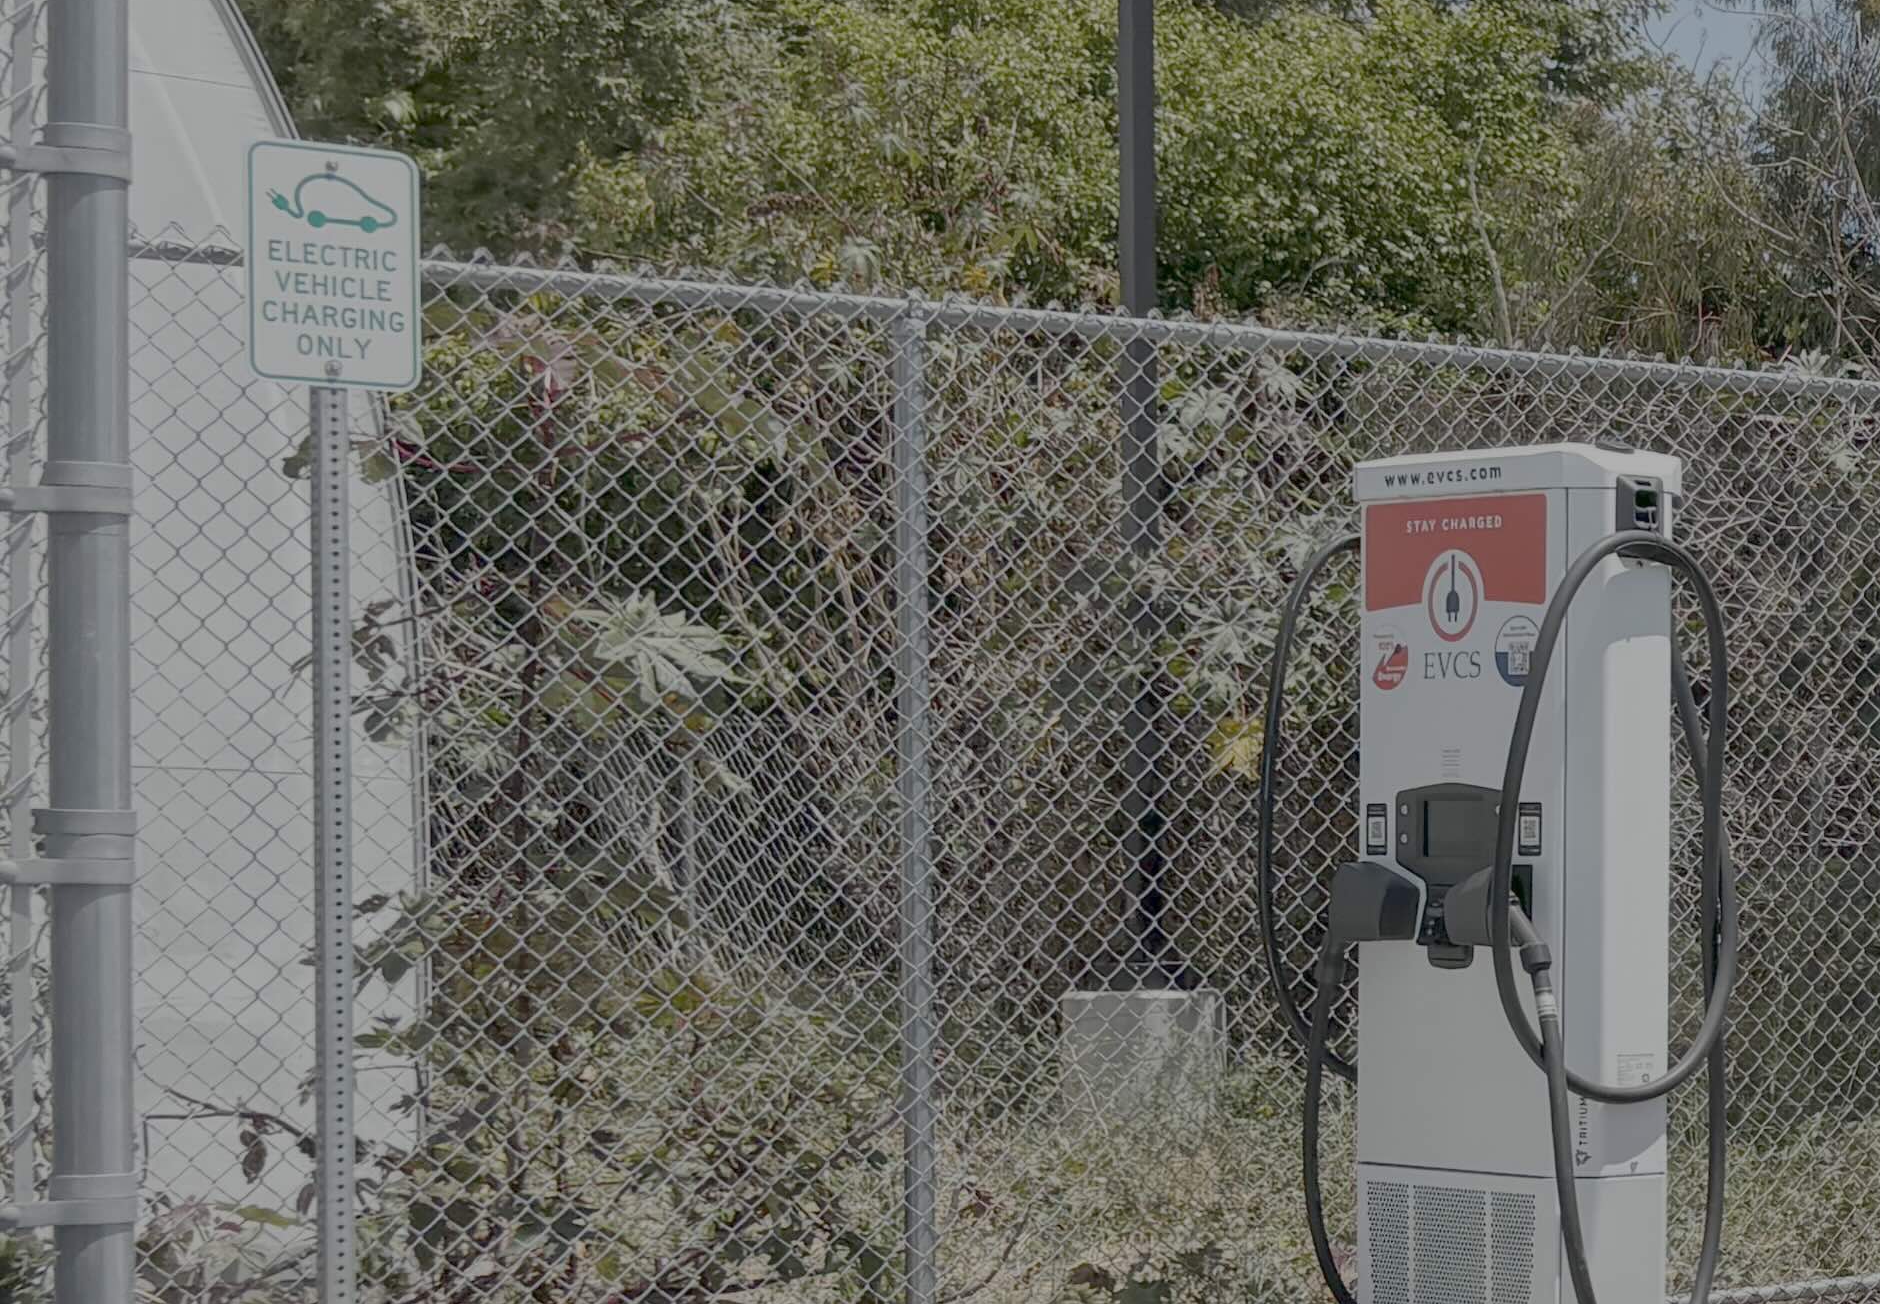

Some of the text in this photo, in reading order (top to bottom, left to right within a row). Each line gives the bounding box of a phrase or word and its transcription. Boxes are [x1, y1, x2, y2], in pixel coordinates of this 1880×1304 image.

[267, 239, 398, 273] ELECTRIC
[275, 270, 392, 302] VEHICLE
[262, 300, 405, 333] CHARGING
[297, 333, 372, 360] ONLY
[1384, 465, 1502, 488] www.evcs.com
[1406, 514, 1503, 534] STAY CHARGED
[1423, 650, 1481, 680] EVCS
[1578, 1097, 1588, 1146] TRITIUM
